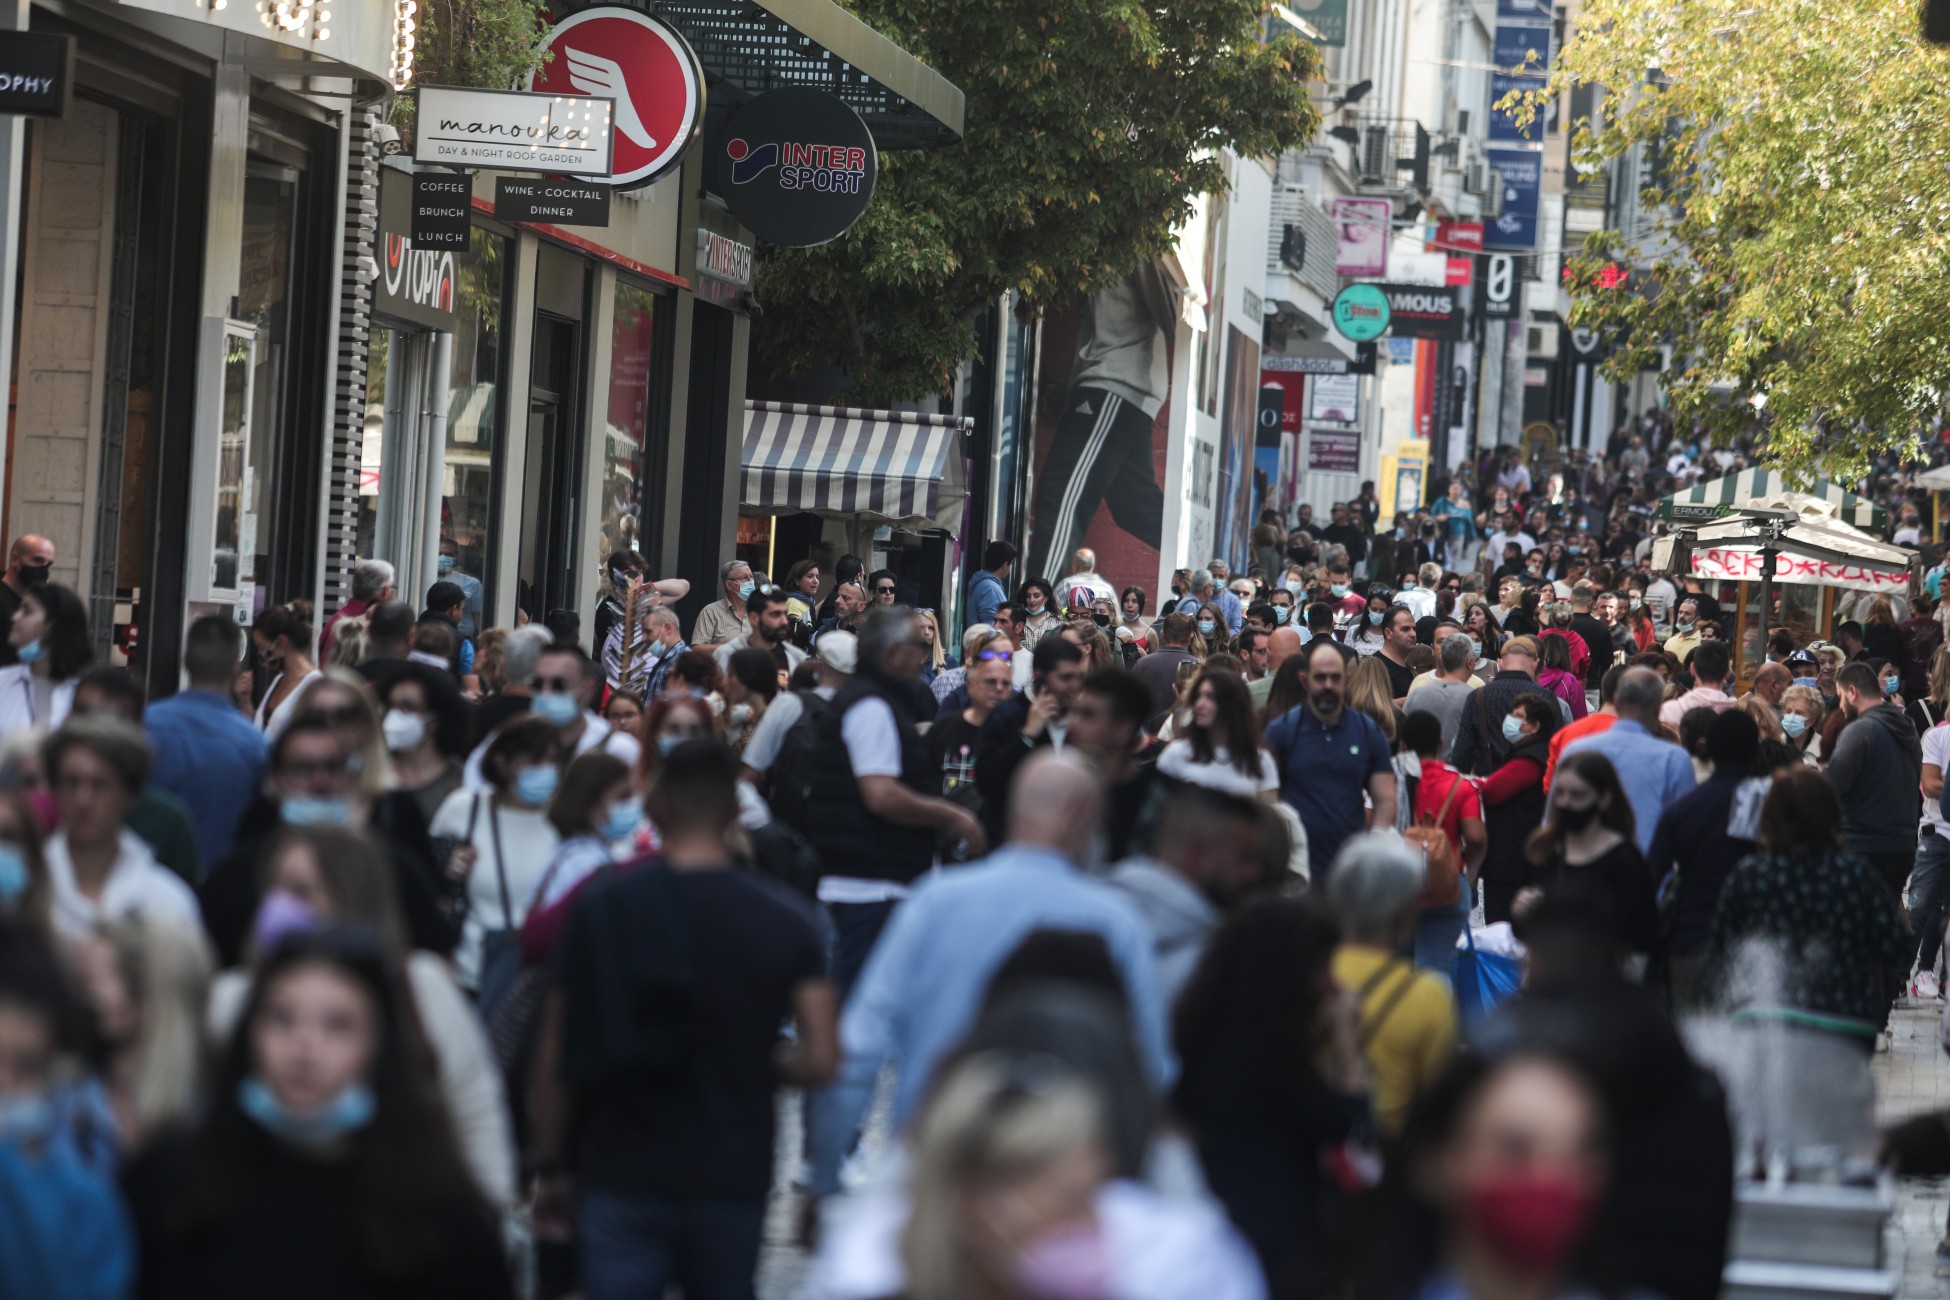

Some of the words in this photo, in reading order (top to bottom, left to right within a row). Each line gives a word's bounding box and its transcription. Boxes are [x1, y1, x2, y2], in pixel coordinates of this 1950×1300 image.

[440, 102, 590, 143] manouka
[438, 145, 458, 156] DAY
[460, 147, 468, 156] &
[470, 147, 503, 159] NIGHT
[506, 150, 536, 161] ROOF
[539, 152, 582, 164] GARDEN
[782, 142, 866, 170] INTER
[780, 166, 864, 193] SPORT
[420, 182, 465, 193] COFFEE
[504, 185, 534, 196] WINE
[545, 188, 602, 200] COCKTAIL
[419, 207, 464, 218] BRUNCH
[530, 205, 574, 217] DINNER
[418, 232, 463, 242] LUNCH
[1673, 507, 1713, 517] ERMOU
